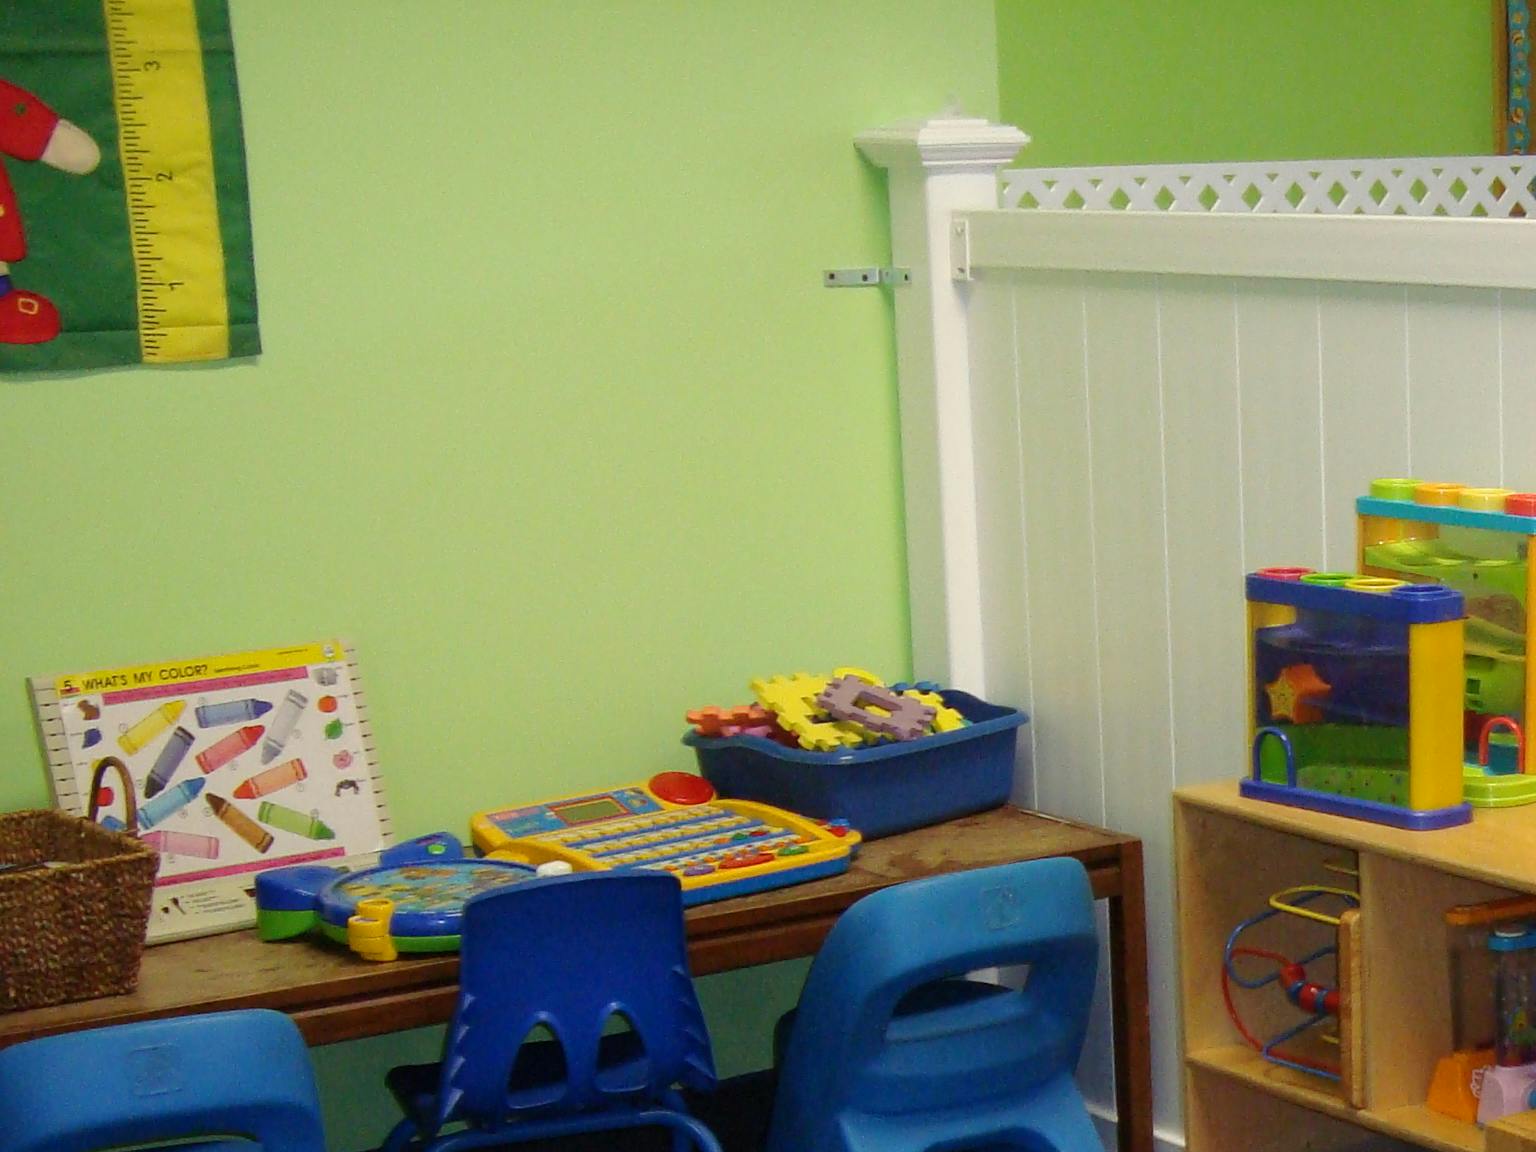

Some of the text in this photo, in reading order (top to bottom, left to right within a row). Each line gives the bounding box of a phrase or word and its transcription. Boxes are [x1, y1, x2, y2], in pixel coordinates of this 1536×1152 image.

[142, 60, 161, 72] 3
[155, 170, 173, 183] 2
[168, 281, 185, 291] 1
[82, 674, 128, 691] WHAT'S
[133, 671, 153, 685] MY
[158, 664, 208, 681] COLOR?
